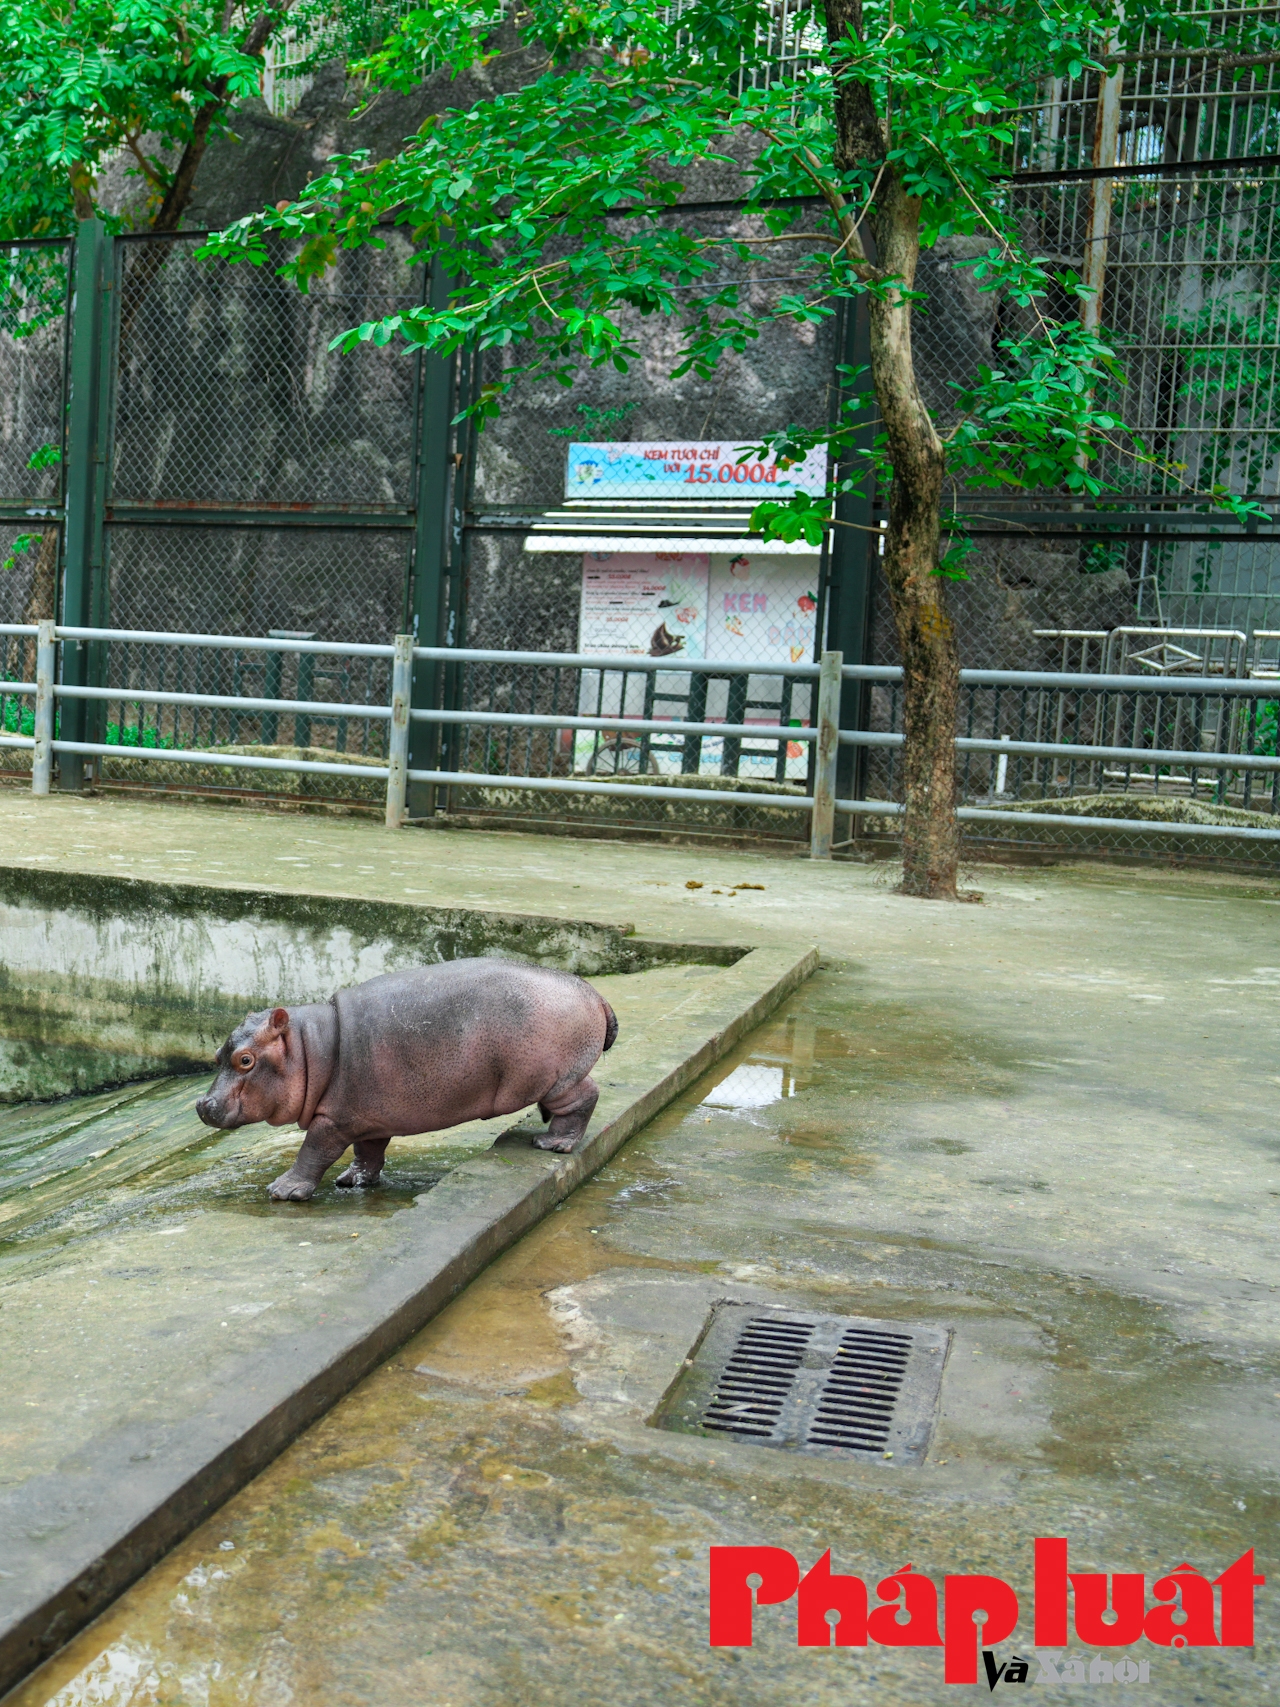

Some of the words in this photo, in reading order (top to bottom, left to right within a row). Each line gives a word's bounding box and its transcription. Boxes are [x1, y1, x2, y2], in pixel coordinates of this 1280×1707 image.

[643, 449, 668, 460] KEM
[683, 463, 779, 484] 15.000đ
[723, 592, 767, 613] KEM
